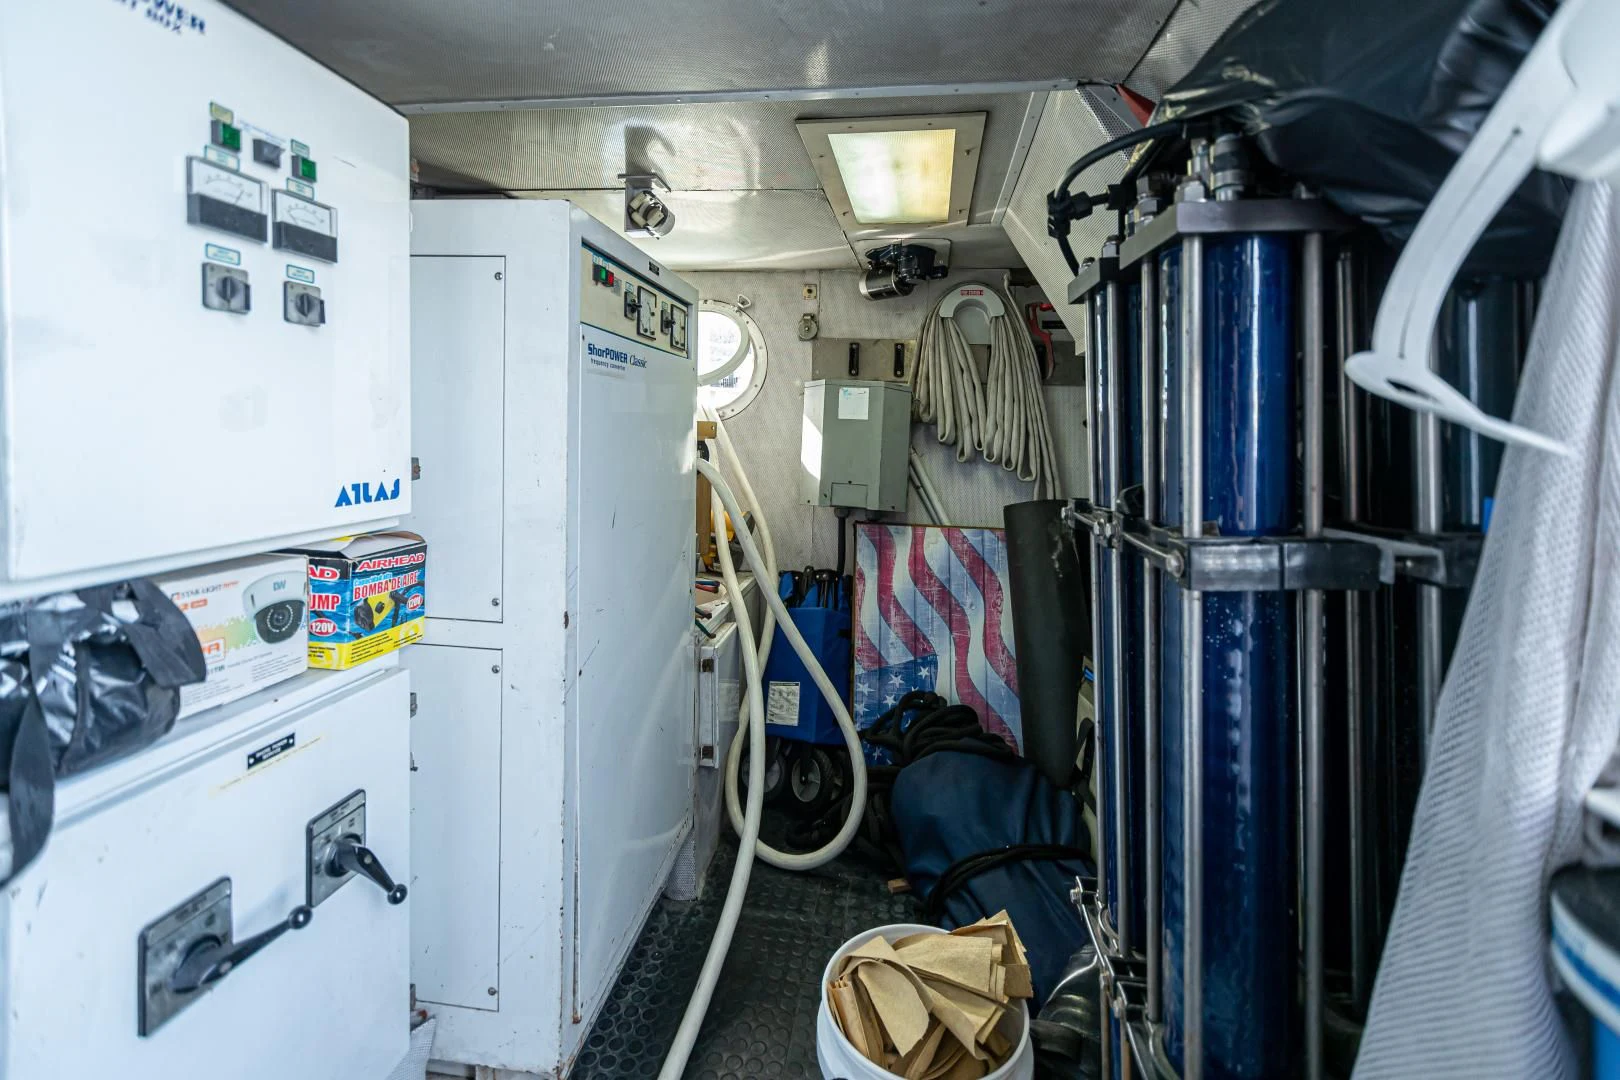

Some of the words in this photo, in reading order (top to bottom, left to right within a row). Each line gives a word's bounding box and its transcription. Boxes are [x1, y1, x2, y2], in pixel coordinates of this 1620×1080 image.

[587, 343, 628, 364] ShorPOWER
[630, 354, 648, 369] Classic
[334, 478, 401, 508] ATLAS
[356, 552, 425, 572] AIRHEAD
[353, 578, 390, 601] BOMBA
[391, 576, 401, 591] DE
[402, 570, 418, 587] AIRE
[310, 621, 335, 634] 120V
